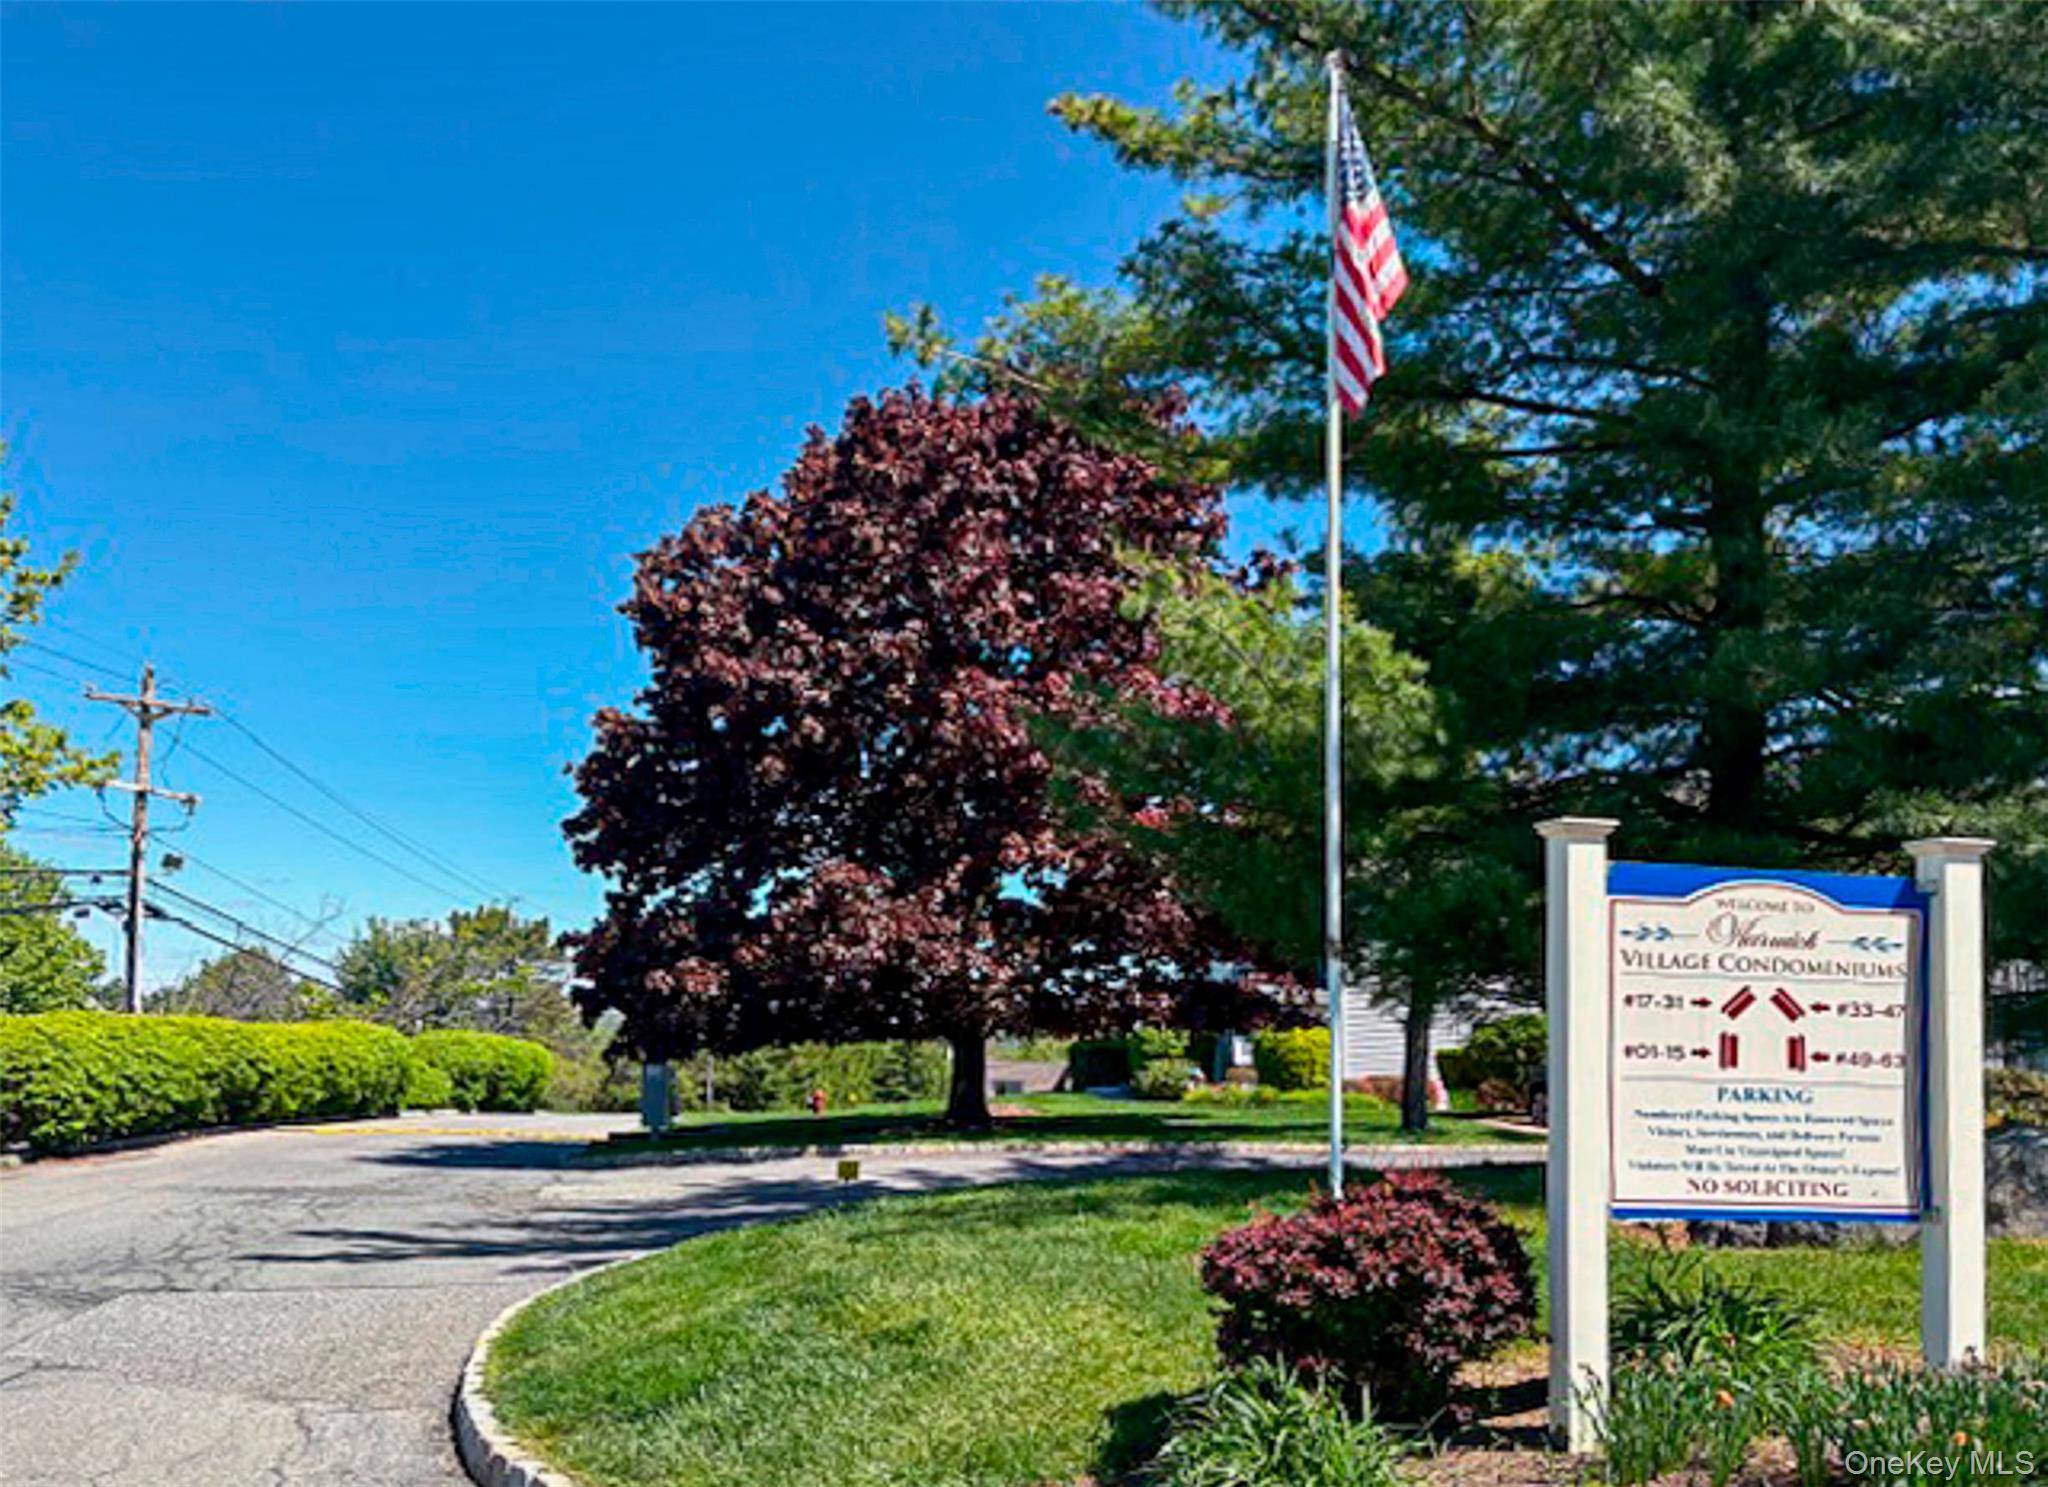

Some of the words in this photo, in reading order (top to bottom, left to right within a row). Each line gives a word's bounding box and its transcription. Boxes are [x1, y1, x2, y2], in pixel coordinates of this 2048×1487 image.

[1716, 899, 1787, 912] WELCOME
[1793, 902, 1815, 913] TO
[1705, 912, 1821, 950] Warwick
[1620, 949, 1710, 970] VILLAGE
[1623, 995, 1685, 1010] #17-31
[1836, 1002, 1906, 1018] #33-47
[1623, 1045, 1686, 1060] #01-15
[1717, 1087, 1814, 1104] PARKING
[1686, 1178, 1719, 1194] NO
[1722, 1178, 1849, 1197] SOLICITING
